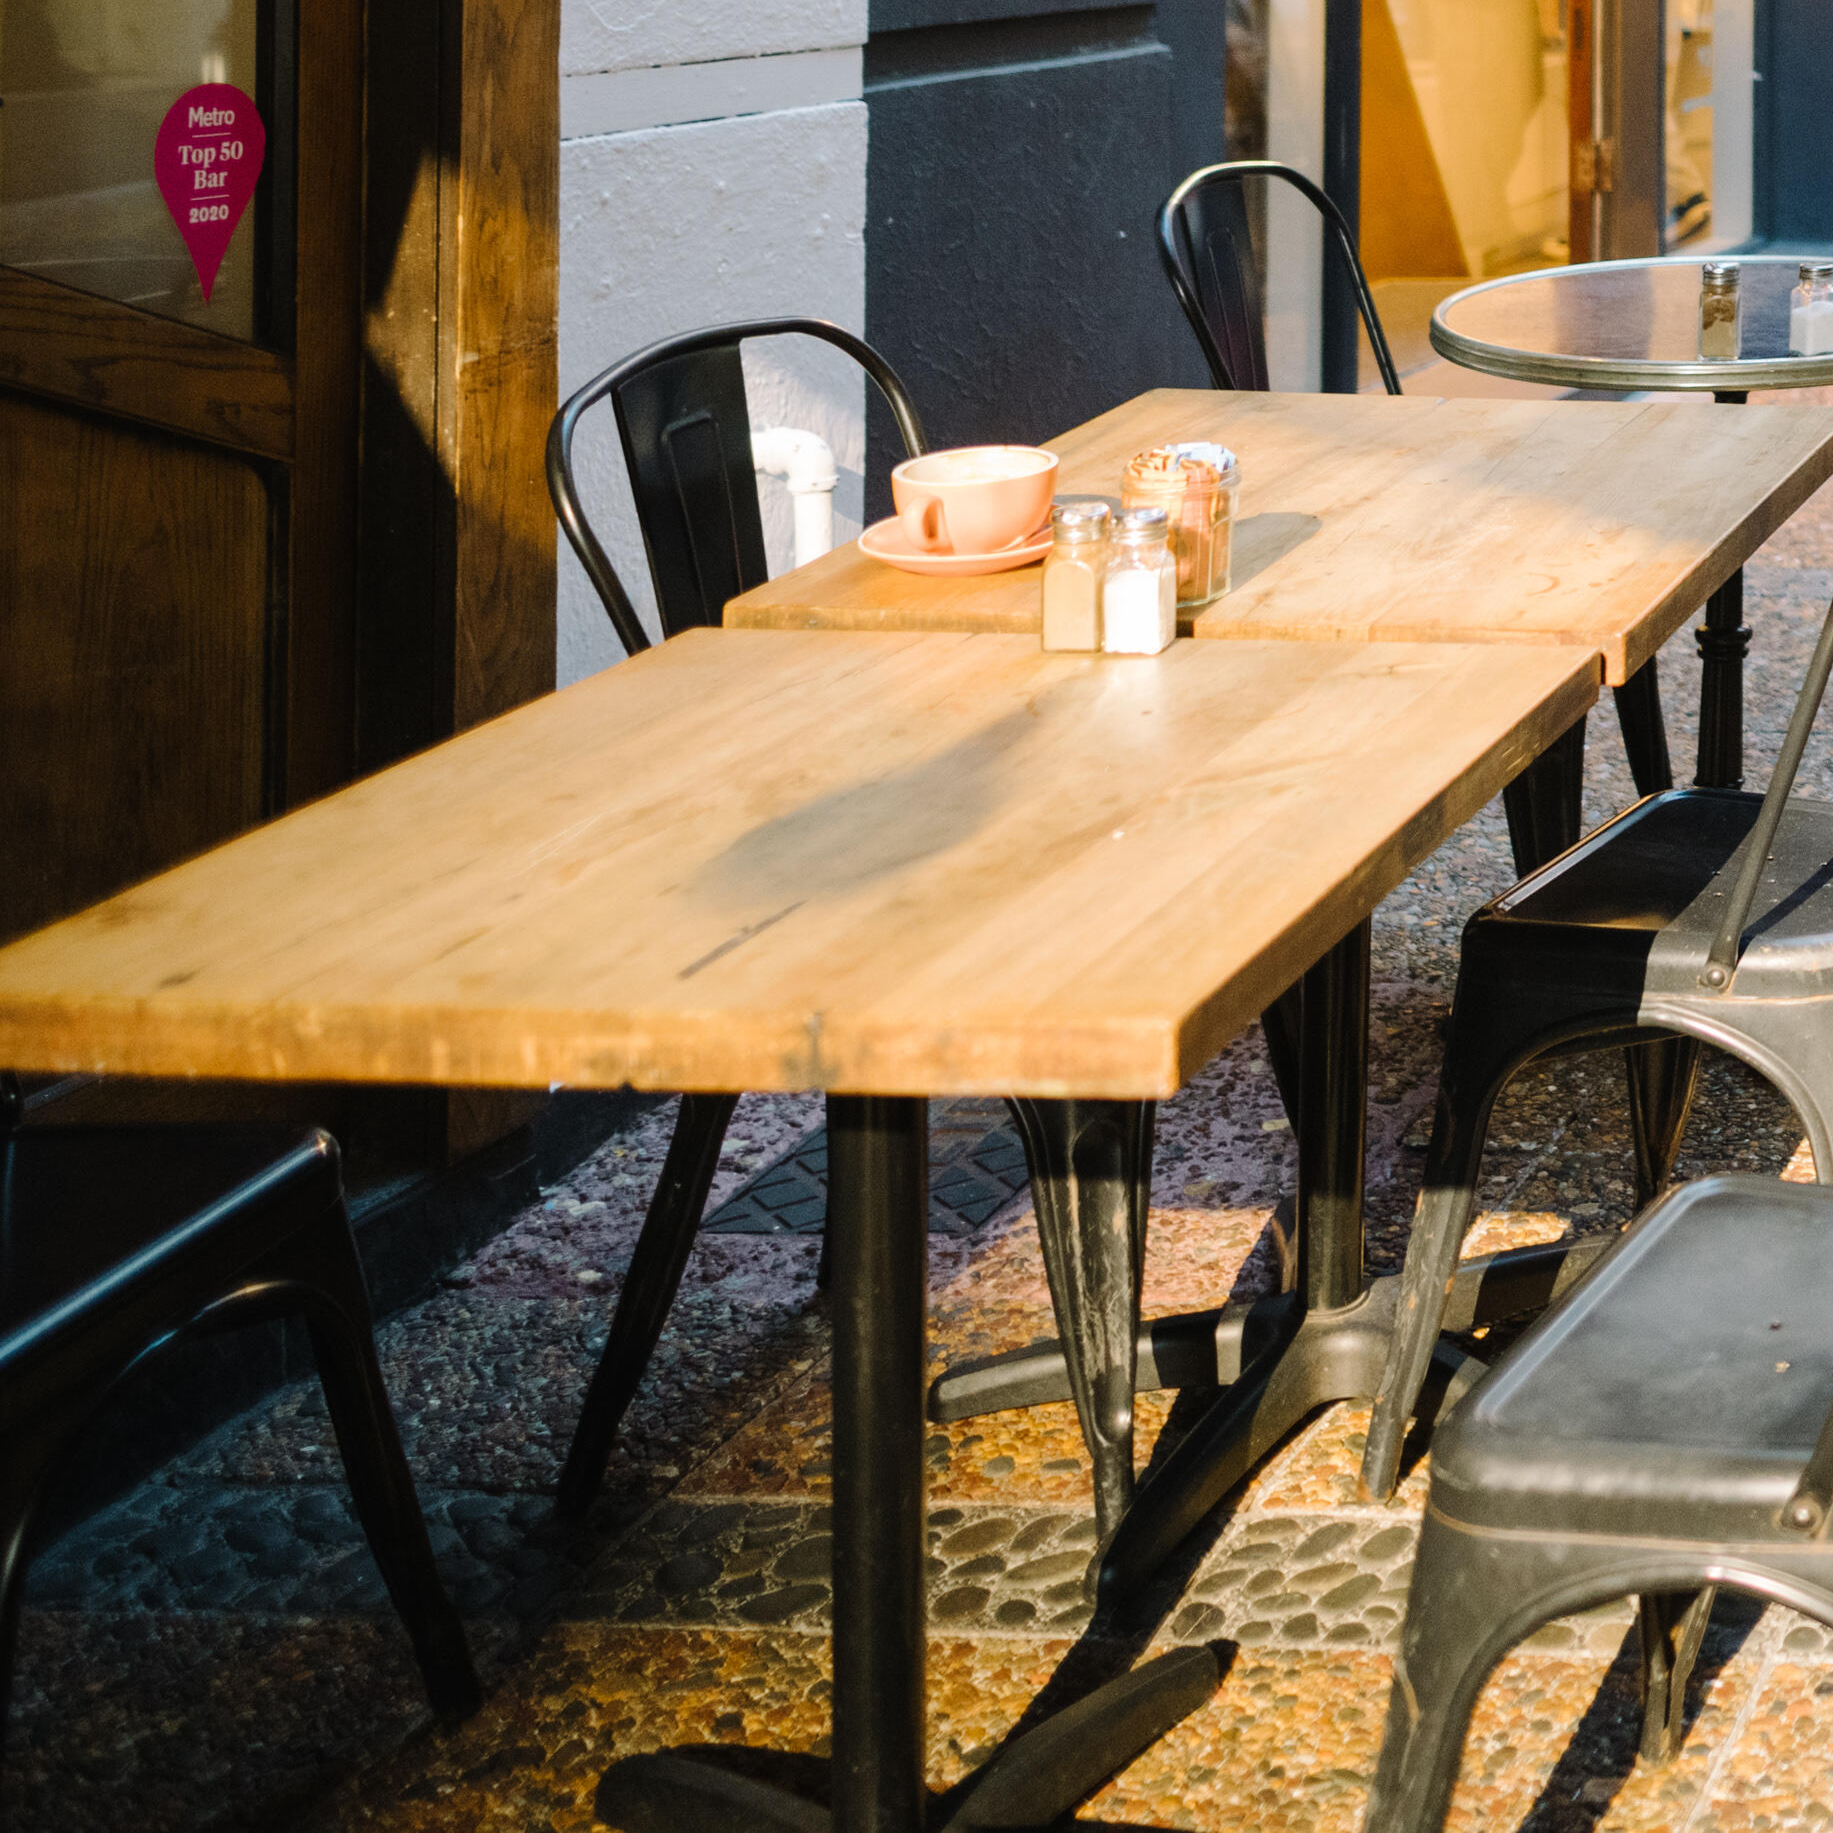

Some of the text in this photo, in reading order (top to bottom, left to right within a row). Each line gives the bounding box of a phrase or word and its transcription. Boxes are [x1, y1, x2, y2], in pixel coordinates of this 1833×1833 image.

[187, 106, 236, 128] Metro
[178, 141, 244, 168] Top 50
[194, 170, 228, 190] Bar
[189, 204, 230, 224] 2020
